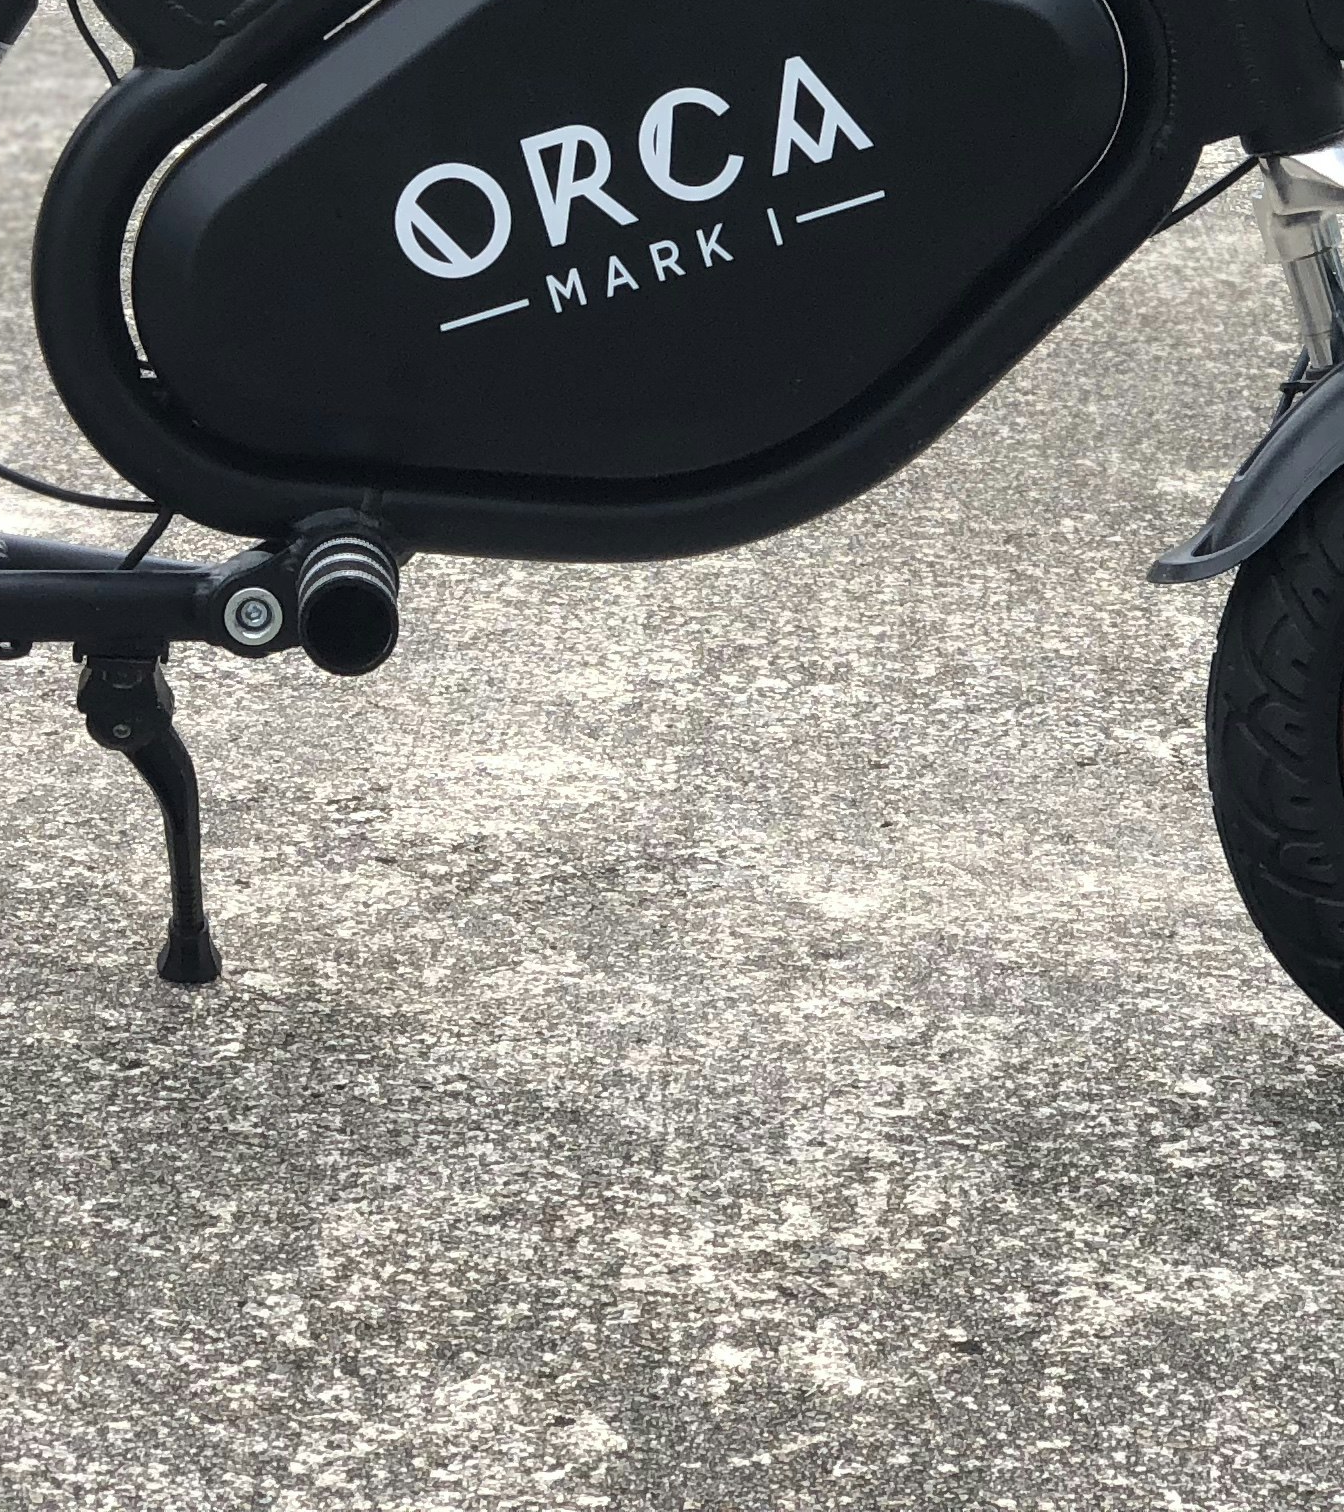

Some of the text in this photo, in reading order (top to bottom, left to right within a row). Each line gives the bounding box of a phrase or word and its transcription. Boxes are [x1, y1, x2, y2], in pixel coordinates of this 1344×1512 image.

[394, 56, 875, 279] ORCA
[545, 207, 784, 314] MARK I
